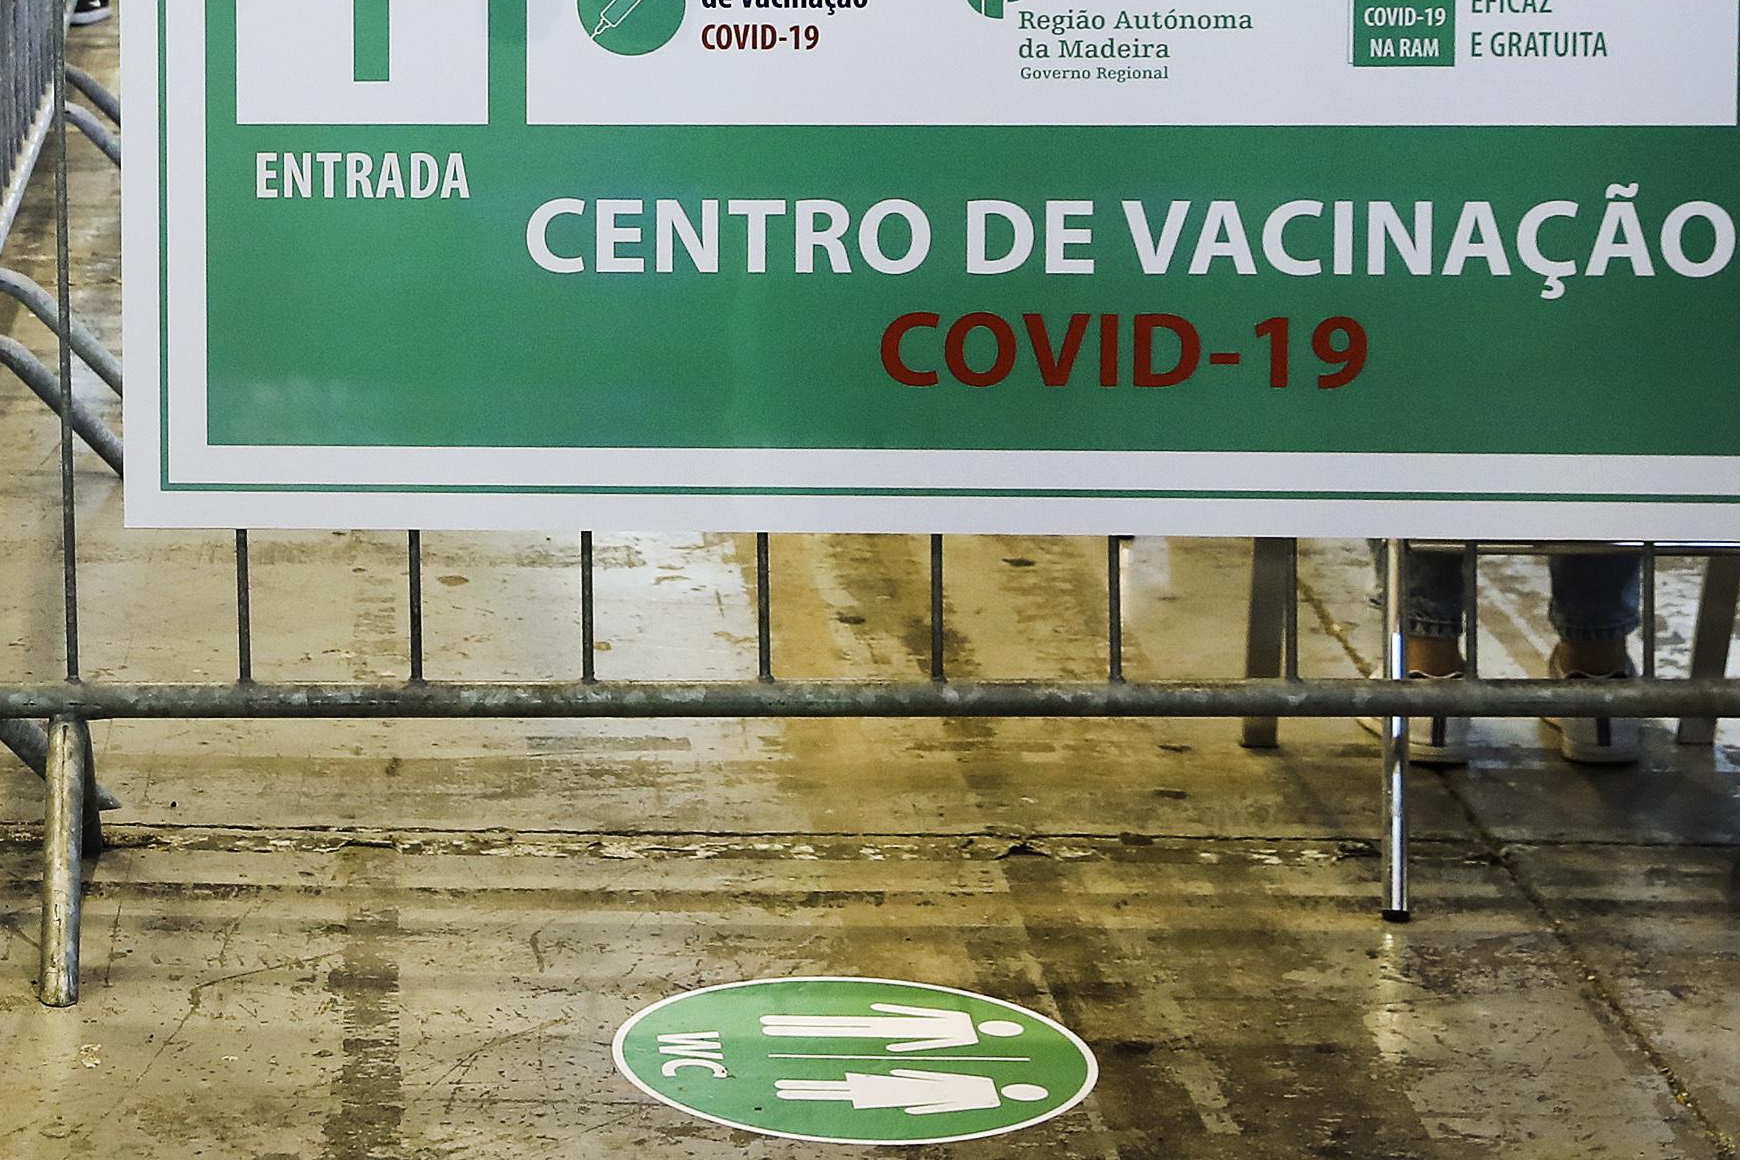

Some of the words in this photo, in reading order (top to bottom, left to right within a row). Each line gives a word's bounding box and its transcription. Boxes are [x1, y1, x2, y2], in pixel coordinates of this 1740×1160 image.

[1018, 9, 1106, 35] Região
[1114, 8, 1253, 30] Autónoma
[1364, 7, 1446, 27] COVID-19
[701, 23, 819, 51] COVID-19
[1018, 38, 1050, 59] da
[1057, 37, 1171, 59] Madeira
[1370, 38, 1396, 58] NA
[1400, 38, 1439, 57] RAM
[1471, 31, 1483, 57] E
[1490, 30, 1608, 57] GRATUITA
[1020, 66, 1091, 80] Governo
[1096, 65, 1169, 83] Regional
[254, 152, 470, 200] ENTRADA
[526, 197, 931, 275] CENTRO
[966, 199, 1095, 275] DE
[1121, 182, 1737, 300] VACINAÇÃO
[879, 310, 1368, 391] COVID-19
[656, 1031, 728, 1079] WC
